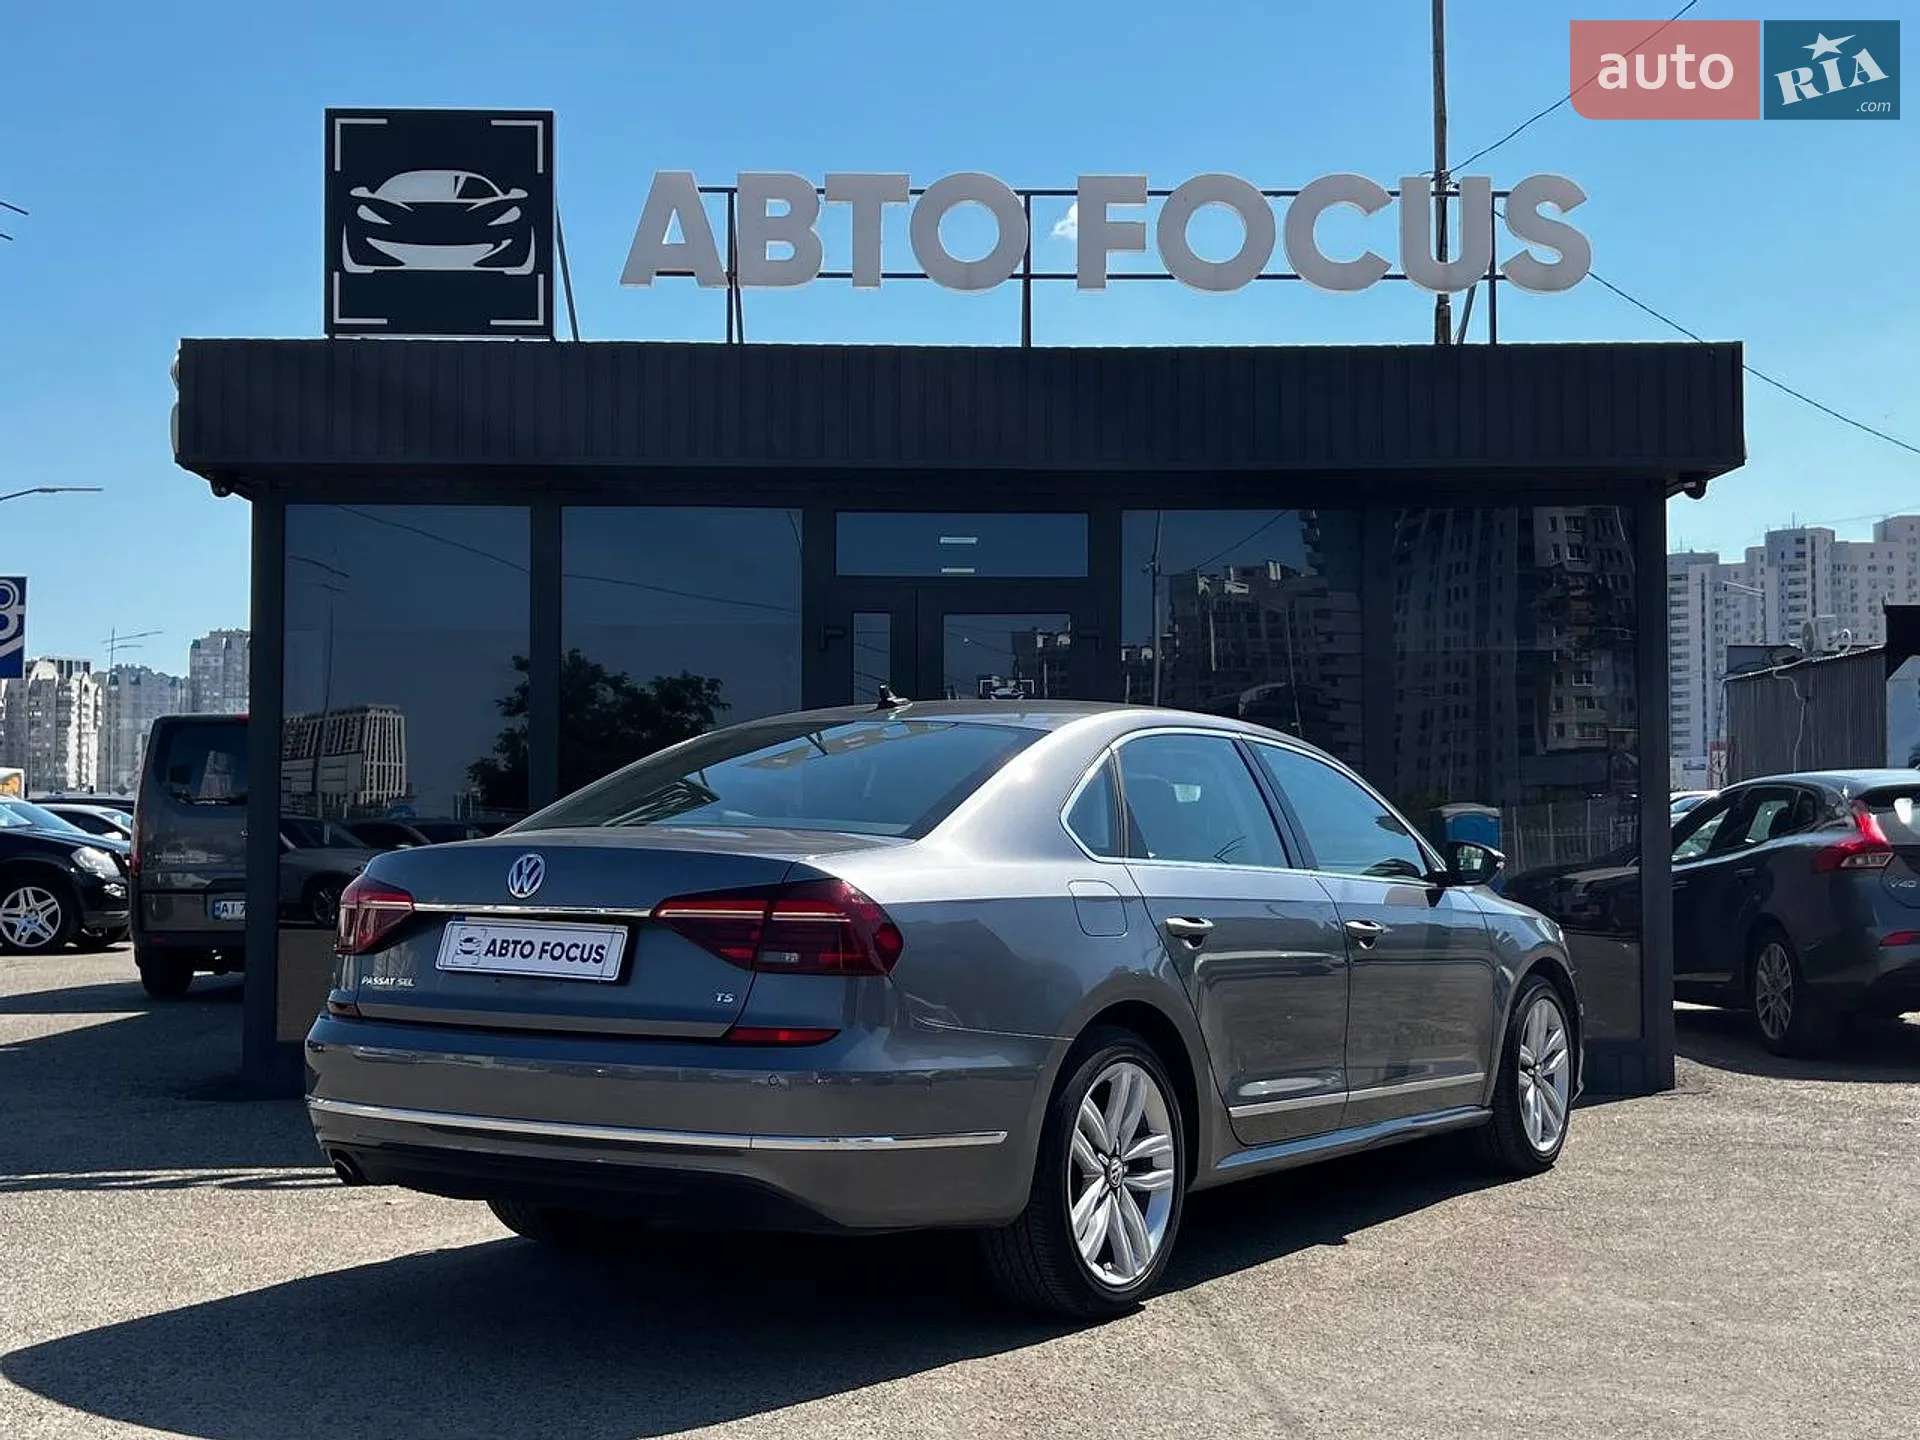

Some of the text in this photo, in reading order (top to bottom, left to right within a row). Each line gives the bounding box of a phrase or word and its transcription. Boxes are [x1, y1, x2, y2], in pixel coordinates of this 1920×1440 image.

[619, 170, 1592, 294] АВТО FOCUS
[484, 937, 606, 964] АВТО FOCUS
[361, 975, 396, 986] PASSAT
